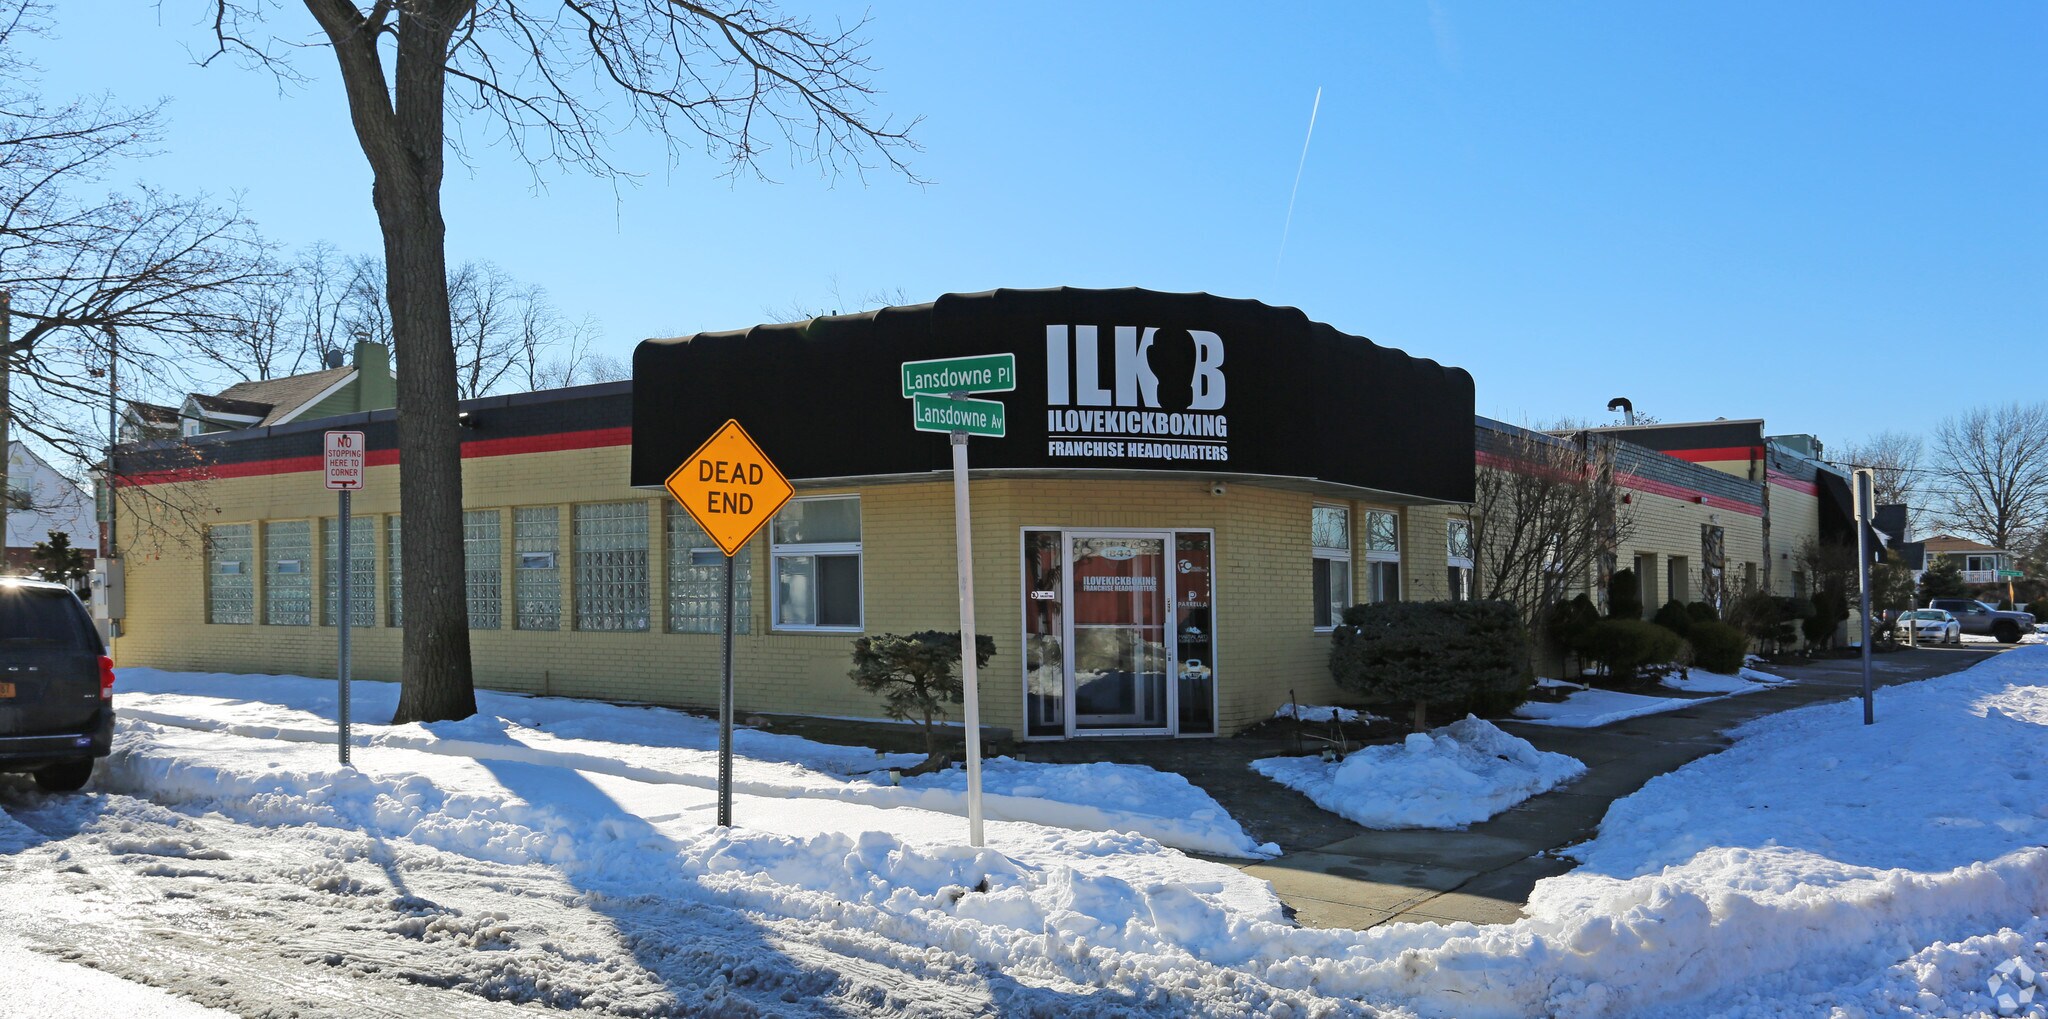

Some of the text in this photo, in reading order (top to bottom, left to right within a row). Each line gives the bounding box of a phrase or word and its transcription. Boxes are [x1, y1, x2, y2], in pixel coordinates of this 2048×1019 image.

[906, 367, 1010, 390] Lansdowne Pl
[917, 401, 1002, 429] Lansdowne Av
[1047, 410, 1228, 438] ILOVEKICKBOXING
[337, 437, 352, 448] NO
[1048, 441, 1228, 461] FRANCHISE HEADQUARTERS
[330, 459, 359, 467] HERE TO
[330, 468, 358, 476] CORNER
[699, 459, 763, 485] DEAD
[708, 491, 754, 515] END
[1083, 576, 1157, 586] ILOVEKICKBOXING
